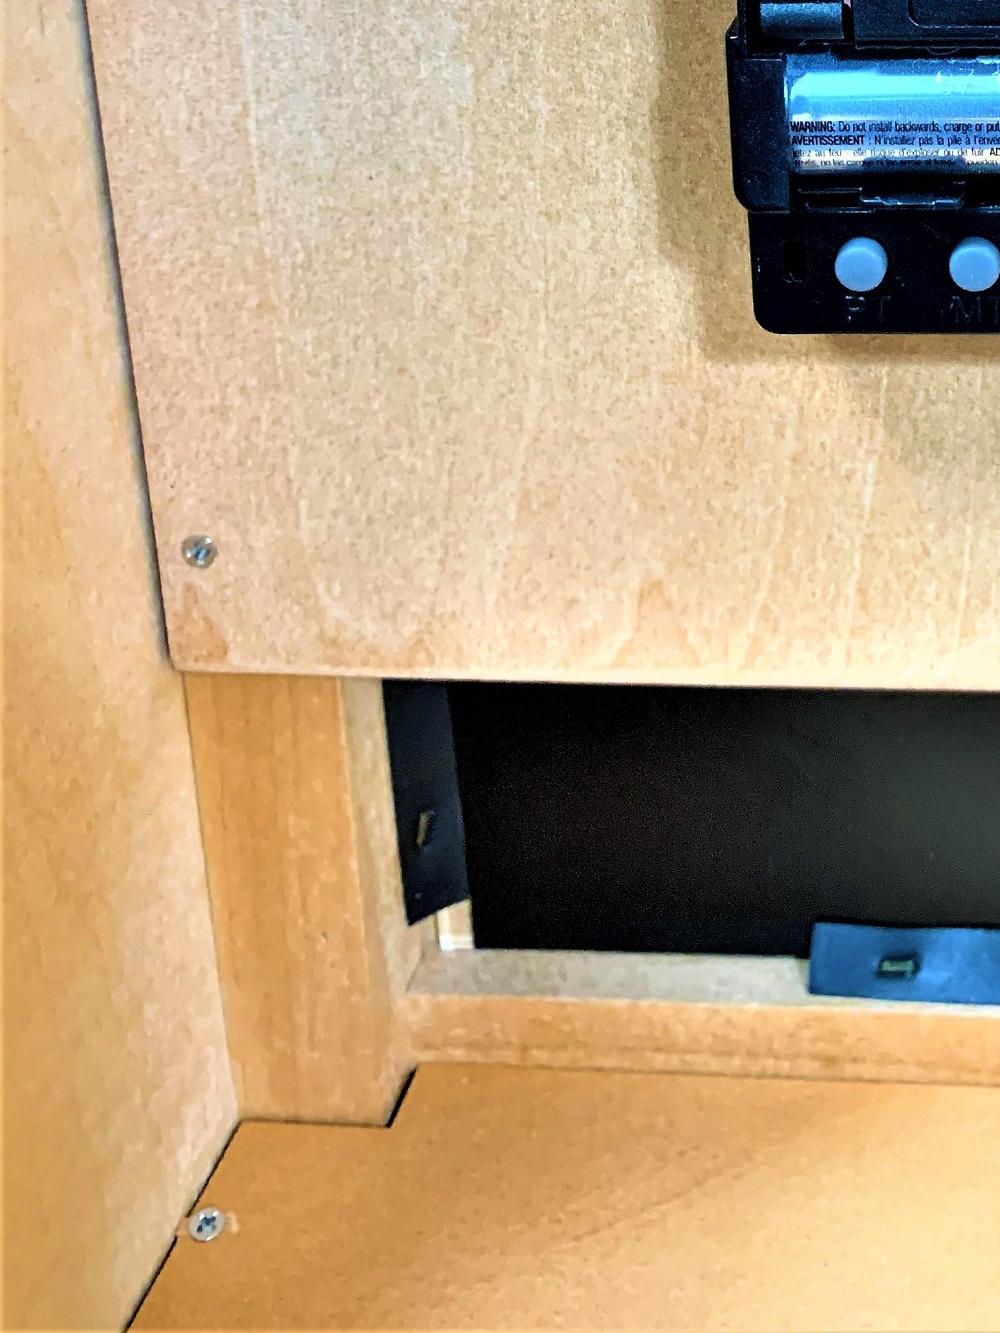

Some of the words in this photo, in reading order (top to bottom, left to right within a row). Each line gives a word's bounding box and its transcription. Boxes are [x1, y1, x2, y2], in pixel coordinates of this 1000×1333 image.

[790, 120, 836, 132] WARNING:
[838, 121, 850, 132] Do
[852, 122, 866, 133] not
[868, 121, 892, 132] install
[895, 121, 941, 133] backwards,
[943, 121, 973, 134] charge
[975, 123, 984, 132] or
[986, 121, 1000, 133] put
[791, 134, 866, 145] AVERTISSEMENT
[918, 136, 934, 147] pas
[936, 135, 945, 145] la
[947, 135, 962, 147] pile
